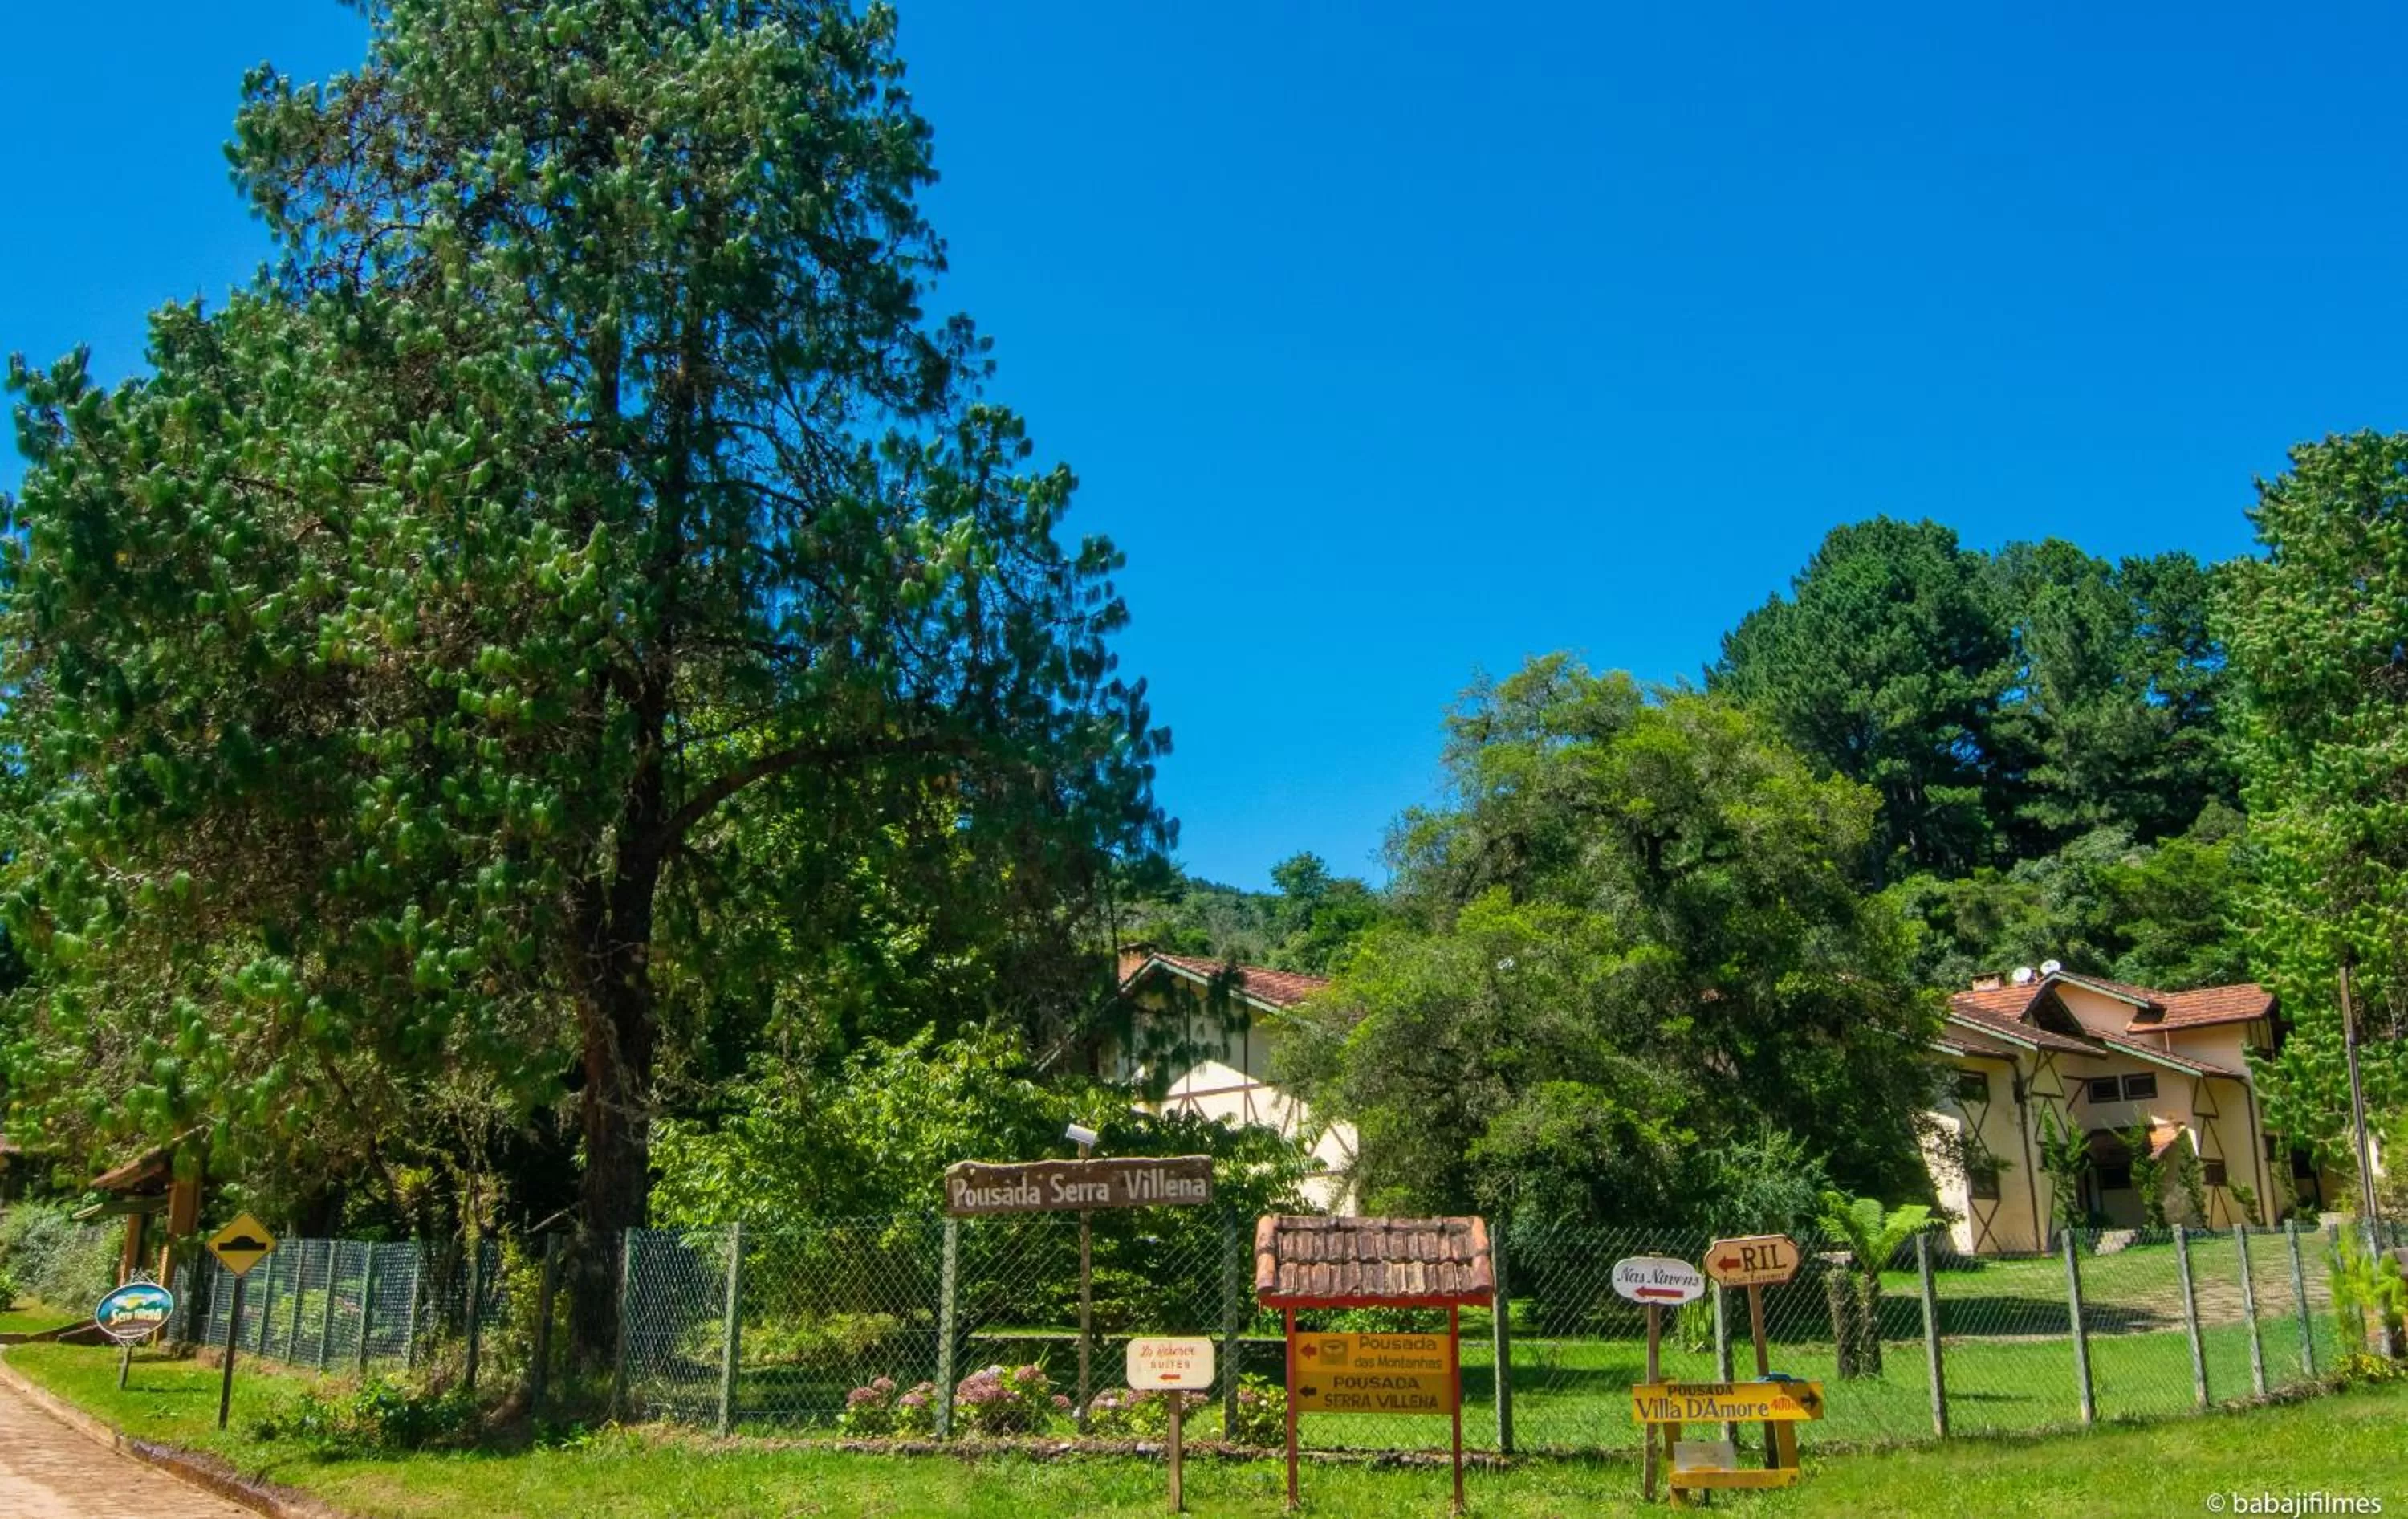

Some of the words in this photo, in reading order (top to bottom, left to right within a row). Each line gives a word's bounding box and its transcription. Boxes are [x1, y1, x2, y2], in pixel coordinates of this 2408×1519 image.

[953, 1171, 1041, 1207] Pousada
[1049, 1173, 1110, 1203] Serra
[1124, 1168, 1206, 1199] Villena
[1740, 1244, 1787, 1273] RIL
[1359, 1335, 1437, 1351] Pousada
[1354, 1355, 1375, 1369] das
[1377, 1355, 1442, 1370] Montanhas
[1333, 1376, 1420, 1390] POUSADA
[1667, 1384, 1735, 1397] POUSADA
[1324, 1394, 1371, 1408] SERRA
[1377, 1394, 1439, 1410] VILLENA
[1634, 1397, 1682, 1419] Villa
[1686, 1396, 1770, 1419] D'Amore
